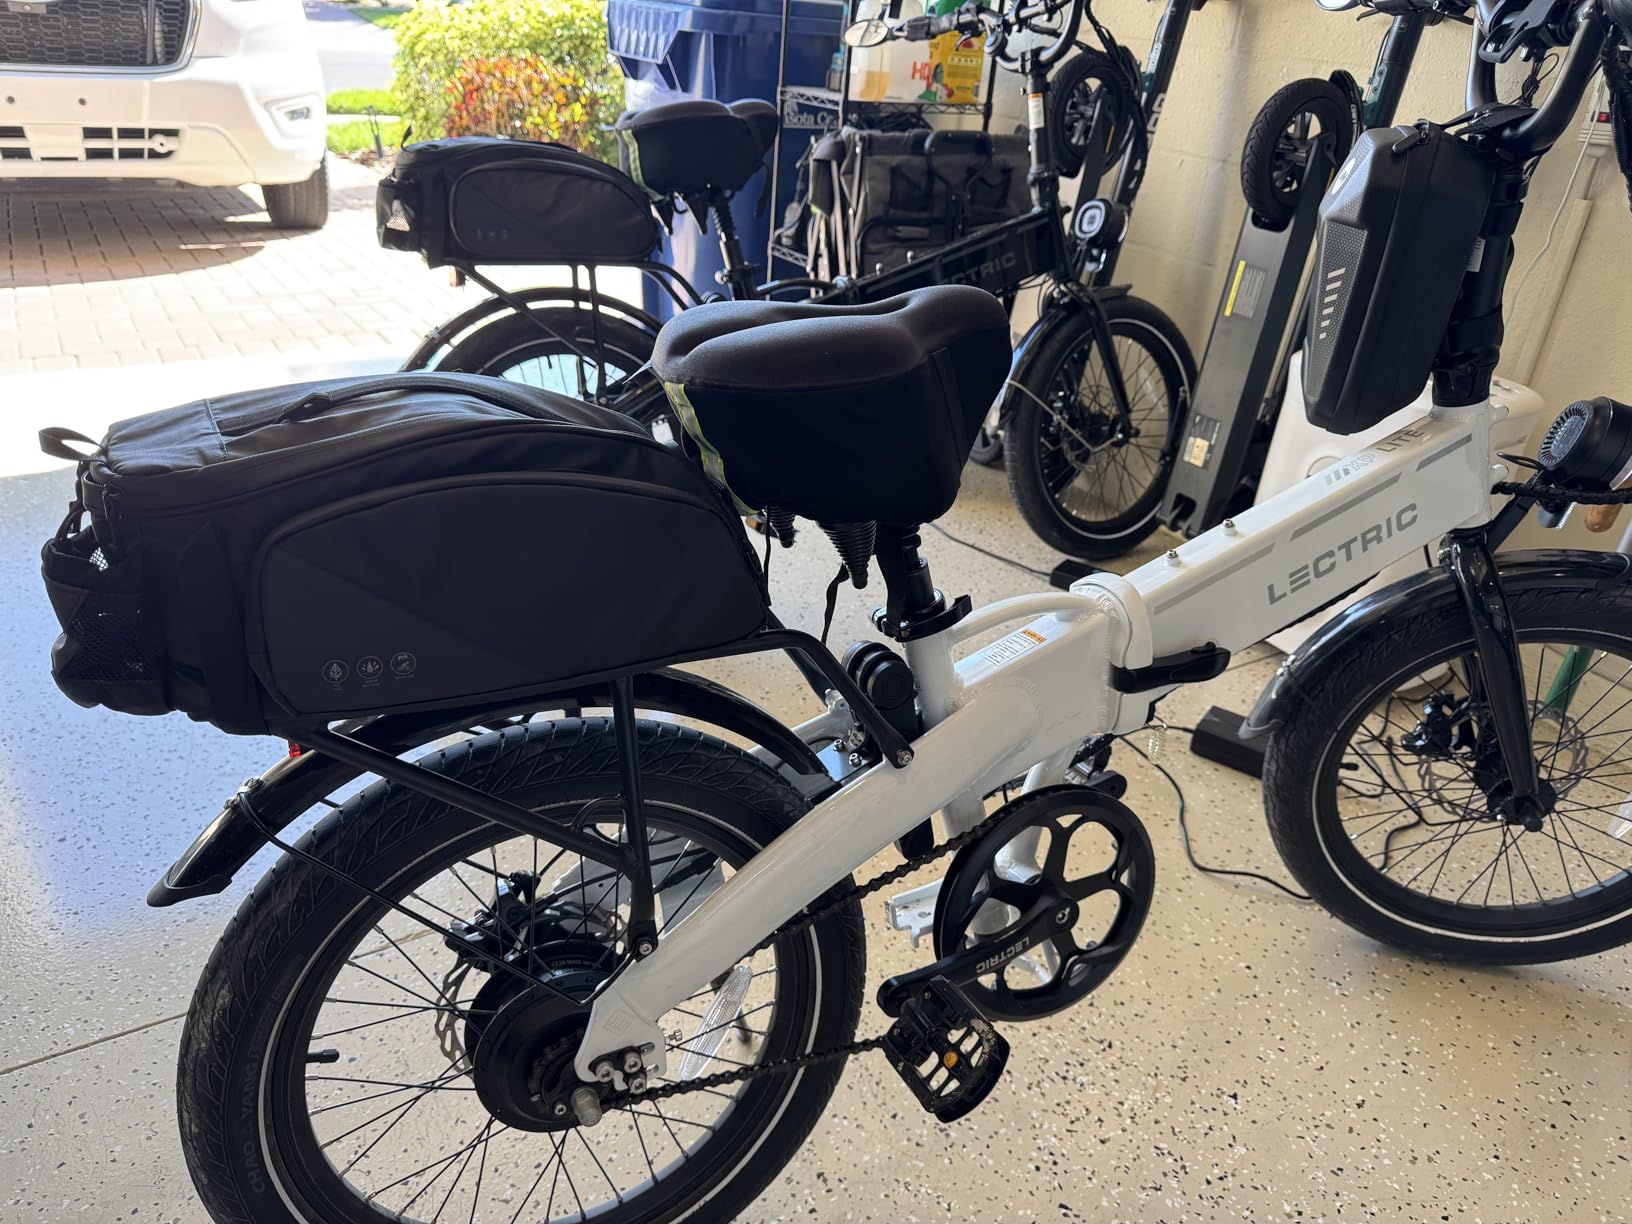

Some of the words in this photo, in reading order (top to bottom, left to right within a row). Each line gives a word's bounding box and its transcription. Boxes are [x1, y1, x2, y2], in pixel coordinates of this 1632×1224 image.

[1376, 429, 1425, 453] LITE
[1267, 502, 1418, 606] LECTRIC
[975, 936, 1030, 974] LECTRIC
